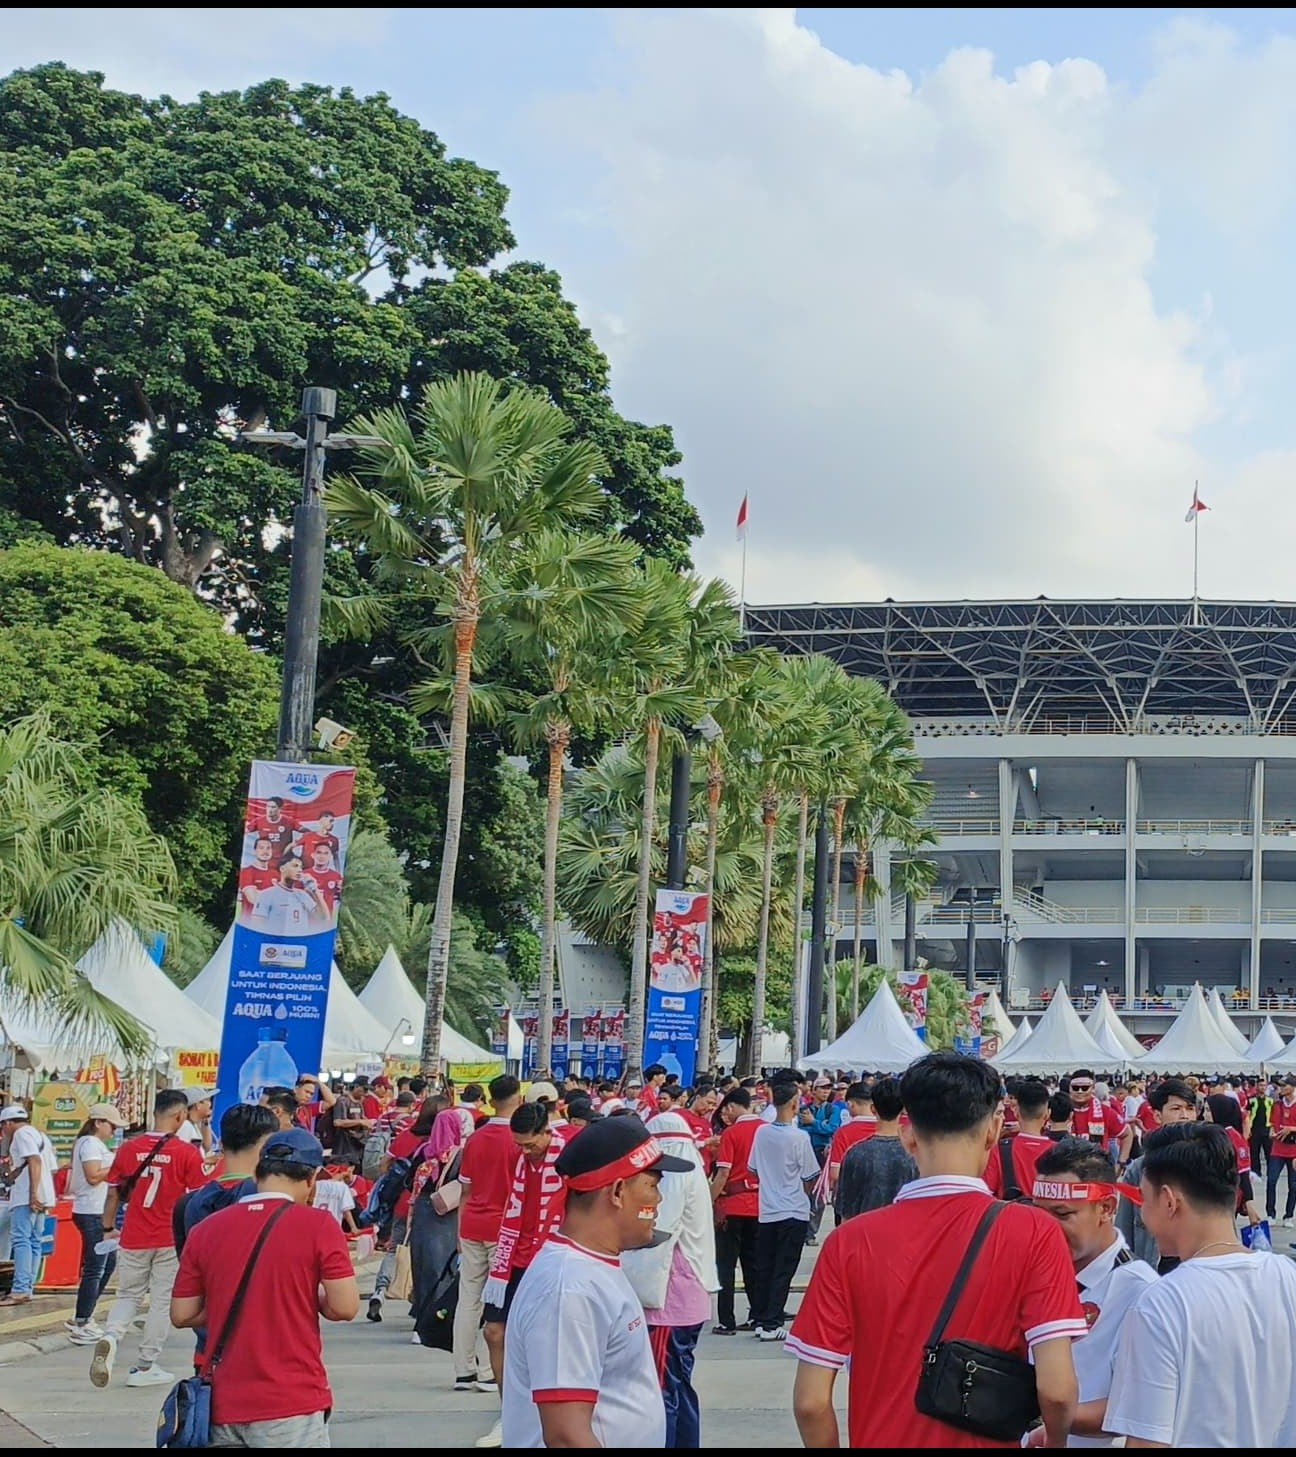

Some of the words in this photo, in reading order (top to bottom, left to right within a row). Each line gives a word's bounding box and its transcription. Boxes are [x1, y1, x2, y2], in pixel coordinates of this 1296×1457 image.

[286, 772, 319, 785] AQUA
[238, 970, 266, 978] SAAT
[267, 971, 323, 981] BERJUANG
[231, 981, 268, 989] UNTUK
[245, 991, 284, 1000] TIMNAS
[286, 993, 312, 1001] PILIH
[232, 1002, 273, 1019] AQUA
[648, 1031, 669, 1041] AQUA
[141, 1166, 163, 1208] 7
[498, 1238, 516, 1273] FORZA
